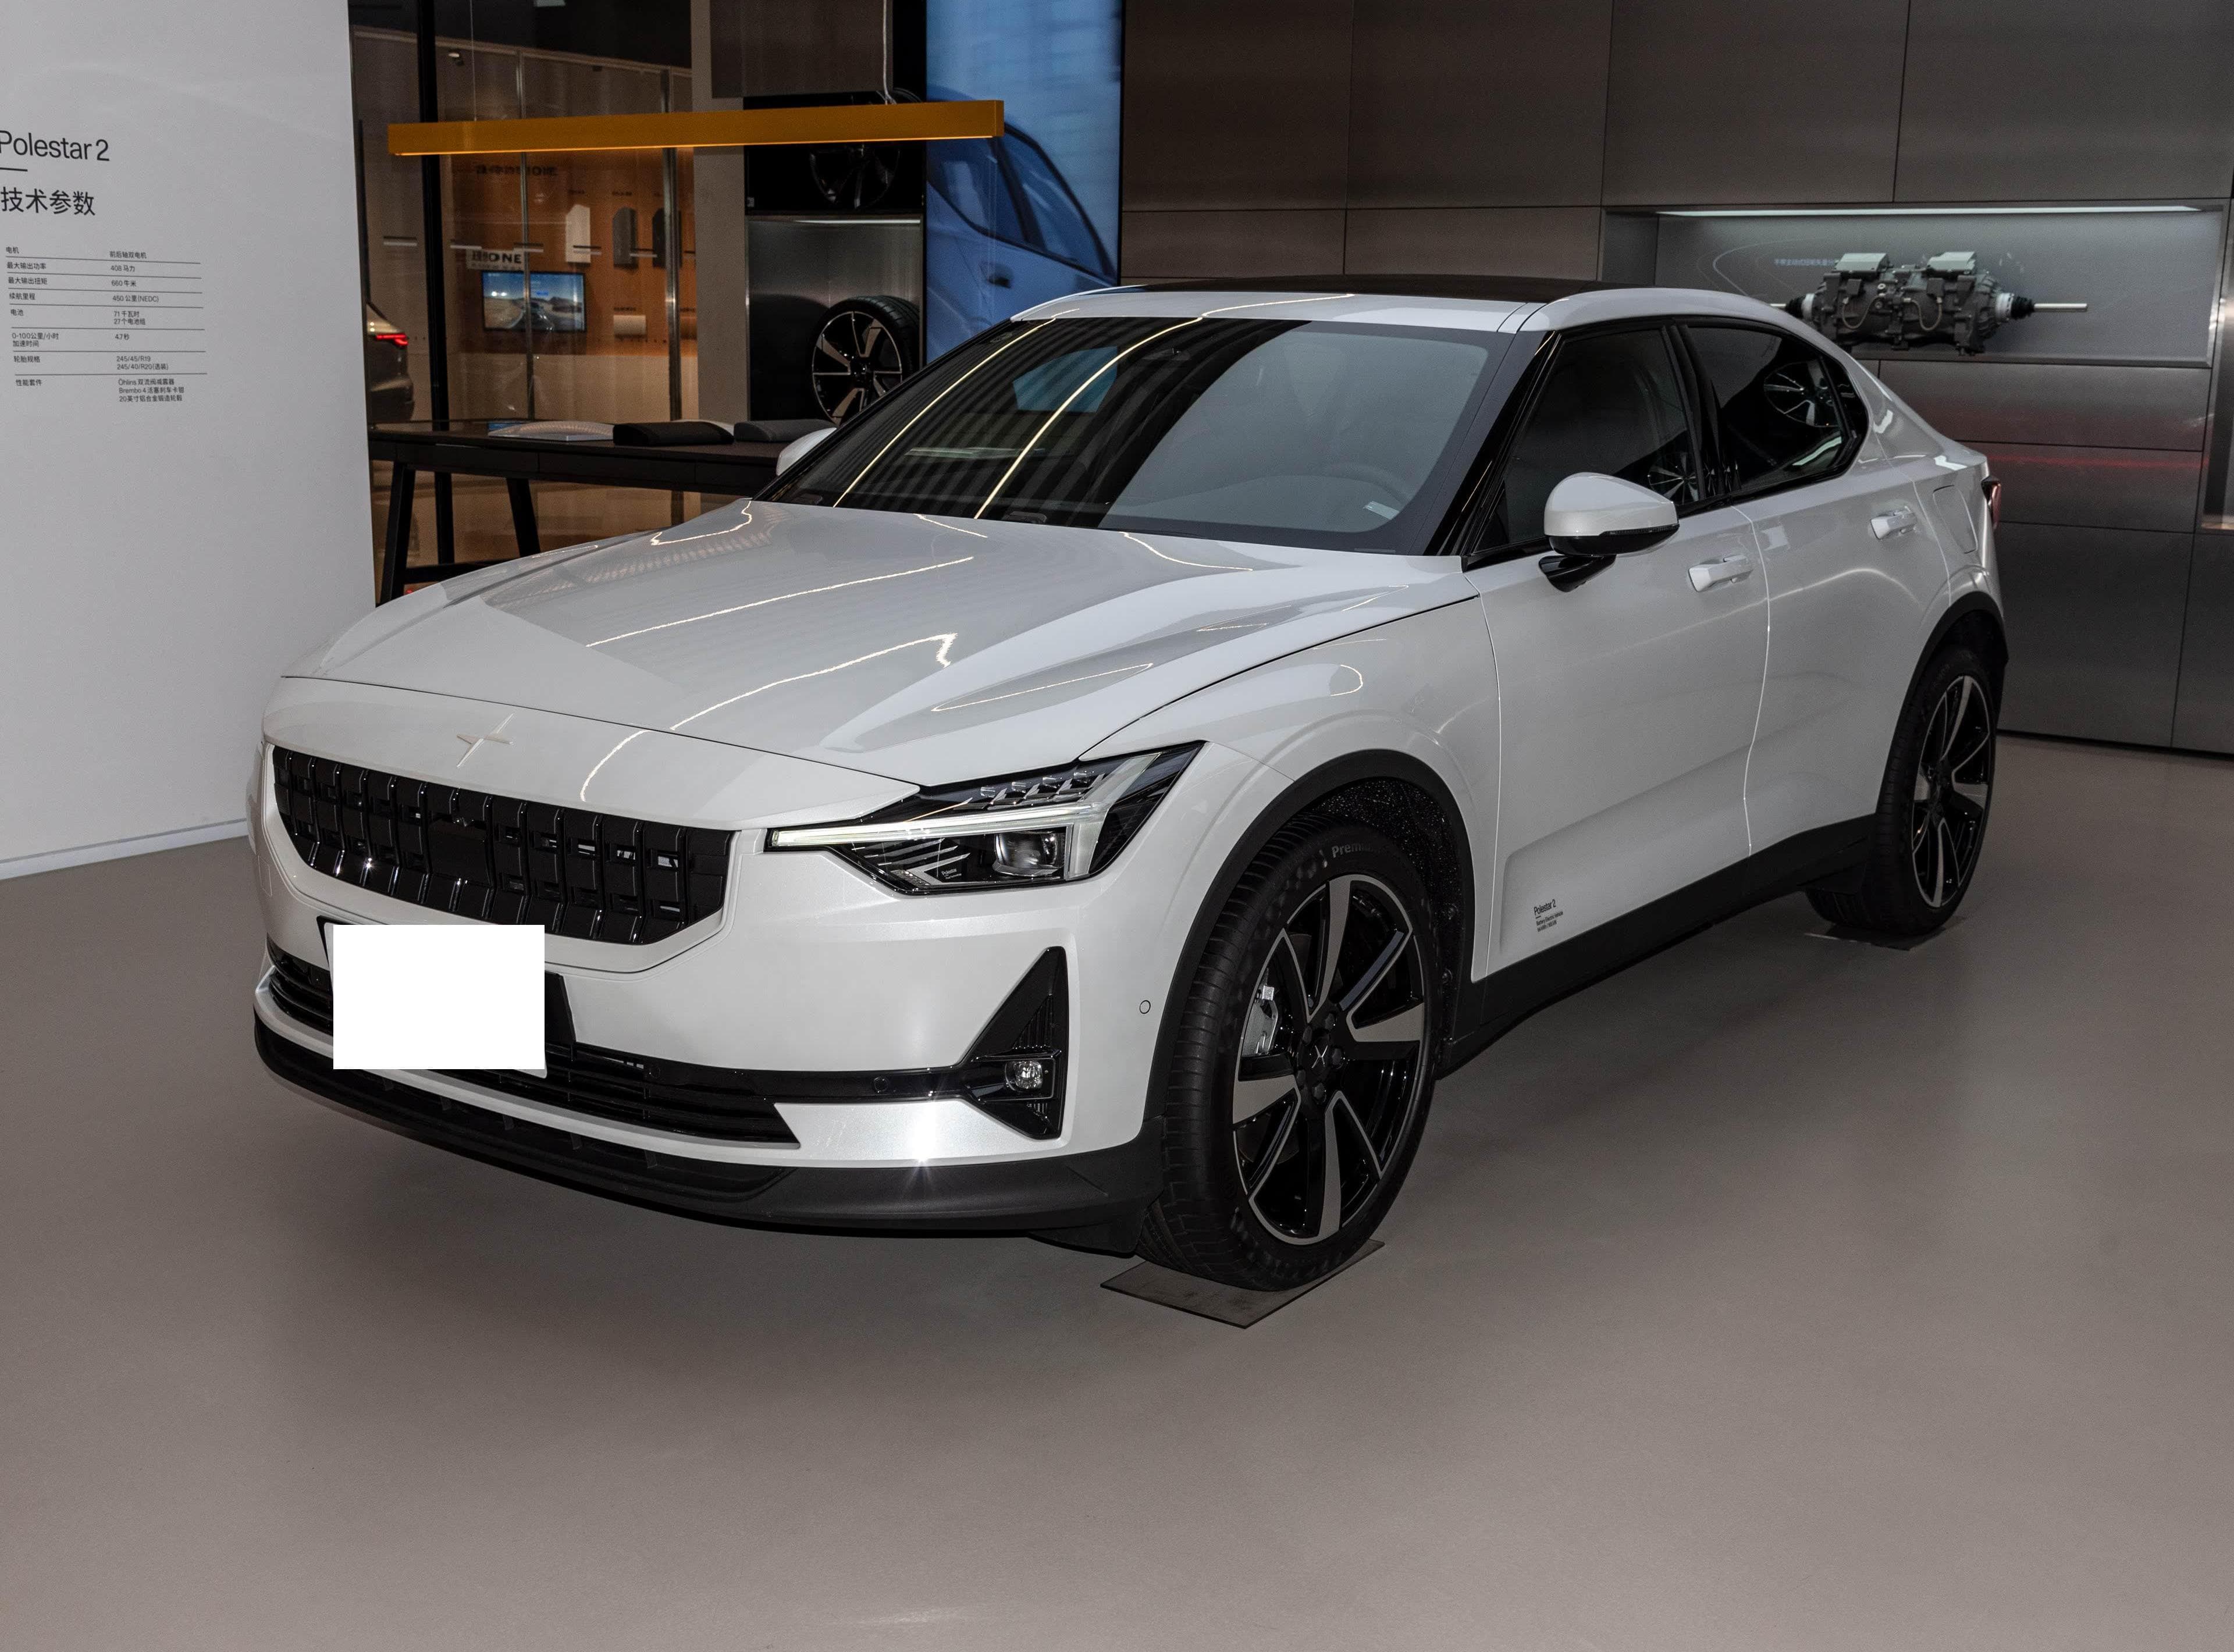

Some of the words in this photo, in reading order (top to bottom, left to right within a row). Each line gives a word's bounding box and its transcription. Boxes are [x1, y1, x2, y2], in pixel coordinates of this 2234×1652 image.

[0, 130, 92, 160] Polestar
[95, 139, 110, 161] 2
[1, 187, 95, 216] 技术参数
[7, 262, 47, 270] 最大输出功率
[8, 277, 47, 285] 最大输出扭矩
[1534, 902, 1552, 916] Polestar
[1552, 899, 1557, 907] 2
